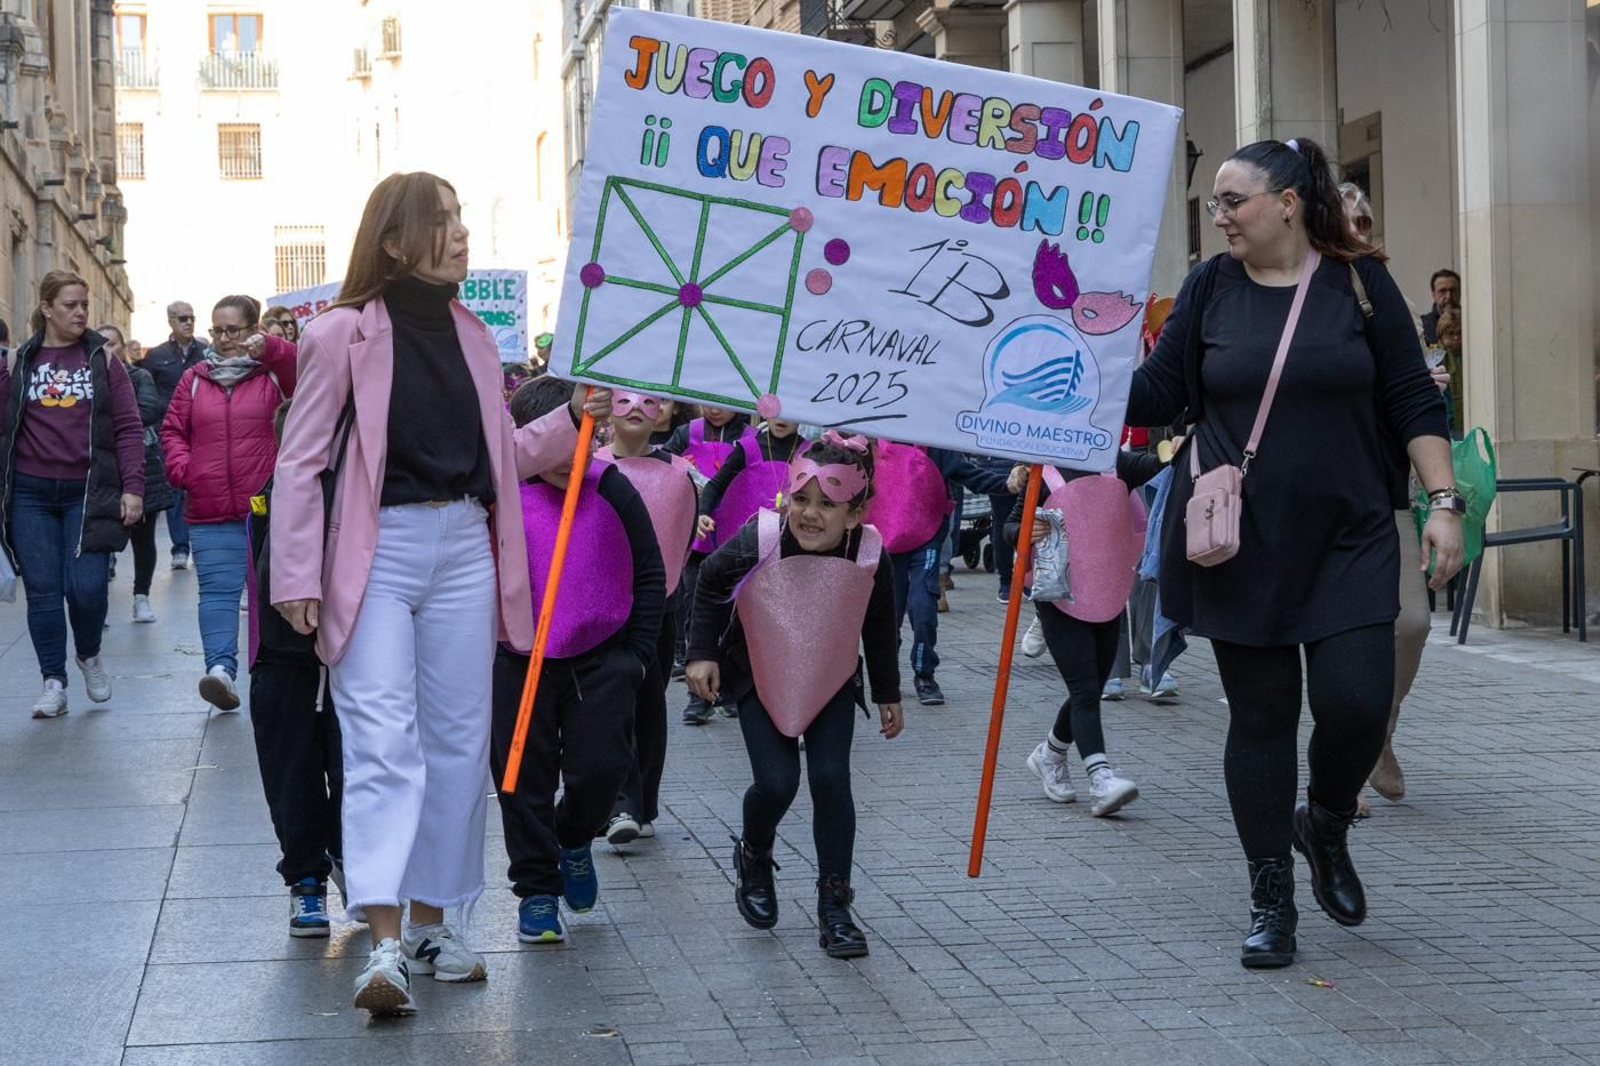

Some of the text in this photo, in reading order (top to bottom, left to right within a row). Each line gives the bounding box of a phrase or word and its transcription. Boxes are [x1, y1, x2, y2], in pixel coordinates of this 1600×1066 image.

[624, 35, 1140, 172] JUEGO Y DIVERSIÓN
[696, 125, 791, 188] QUE
[796, 319, 941, 365] CARNAVAL
[810, 370, 909, 409] 2025
[961, 415, 1107, 447] DIVINO MAESTRO
